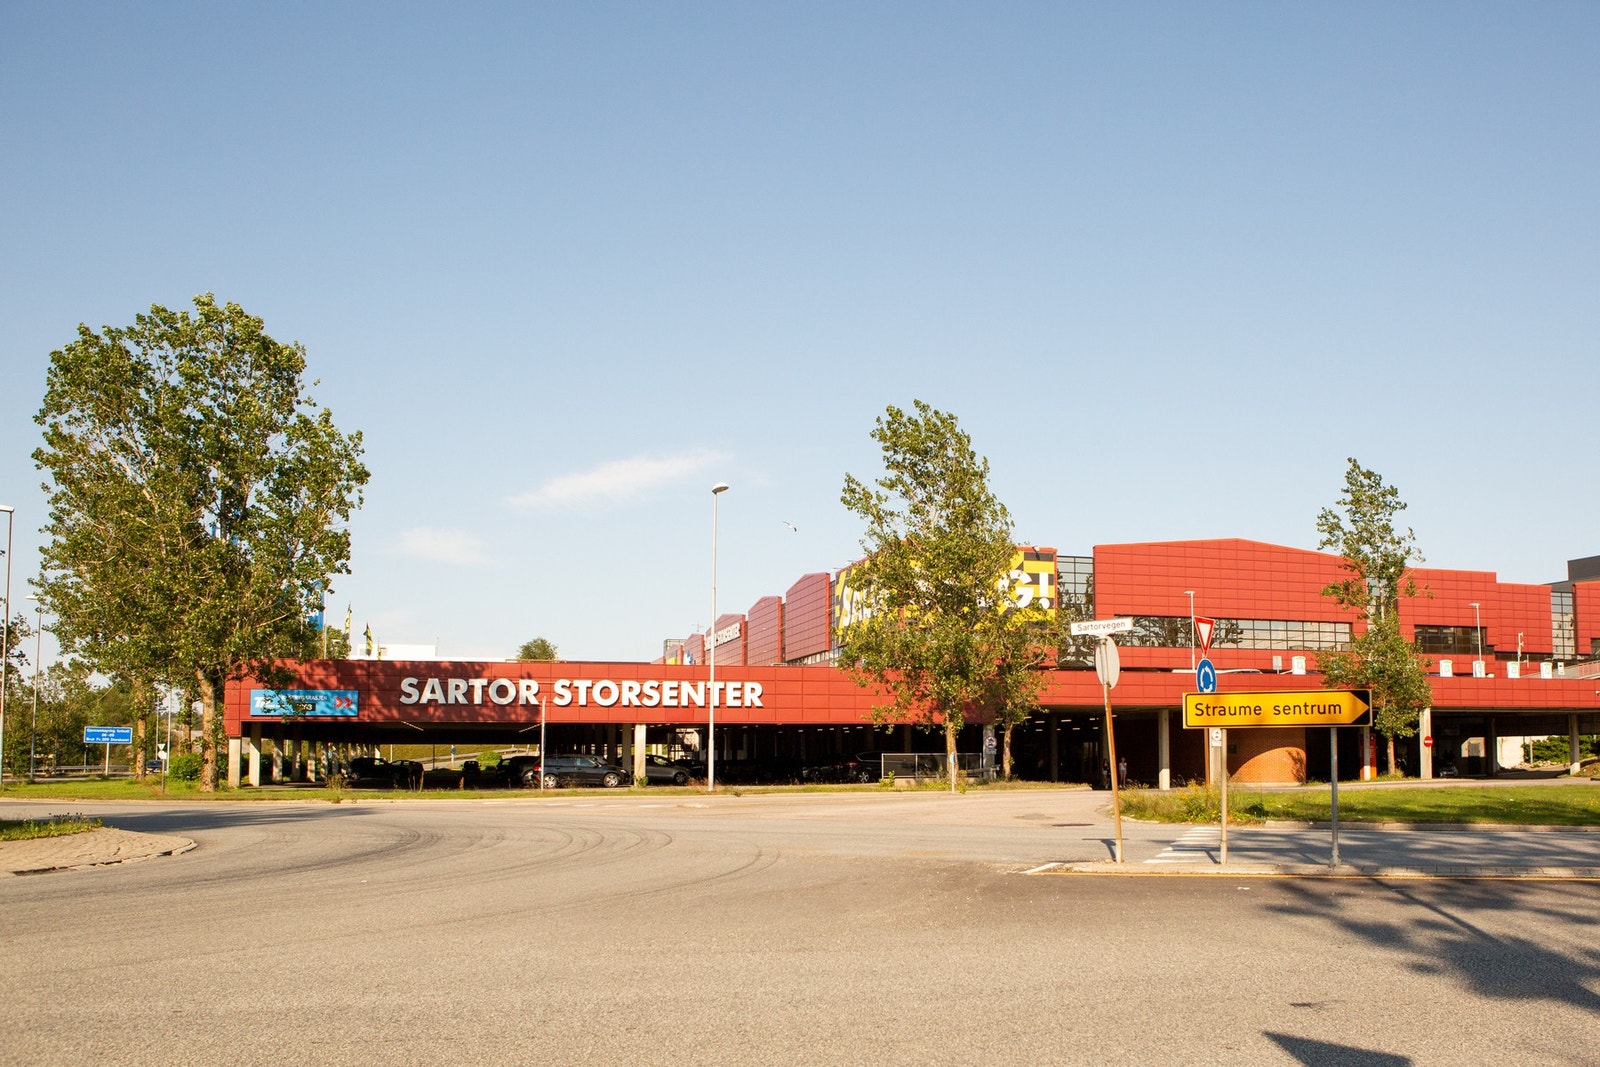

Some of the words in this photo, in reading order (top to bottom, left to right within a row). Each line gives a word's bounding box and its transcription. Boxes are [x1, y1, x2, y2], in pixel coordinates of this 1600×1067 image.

[1077, 621, 1126, 631] Sartorvegen
[399, 677, 540, 705] SARTOR
[552, 678, 764, 706] STORSENTER
[1194, 702, 1262, 716] Straume
[1273, 701, 1342, 715] sentrum
